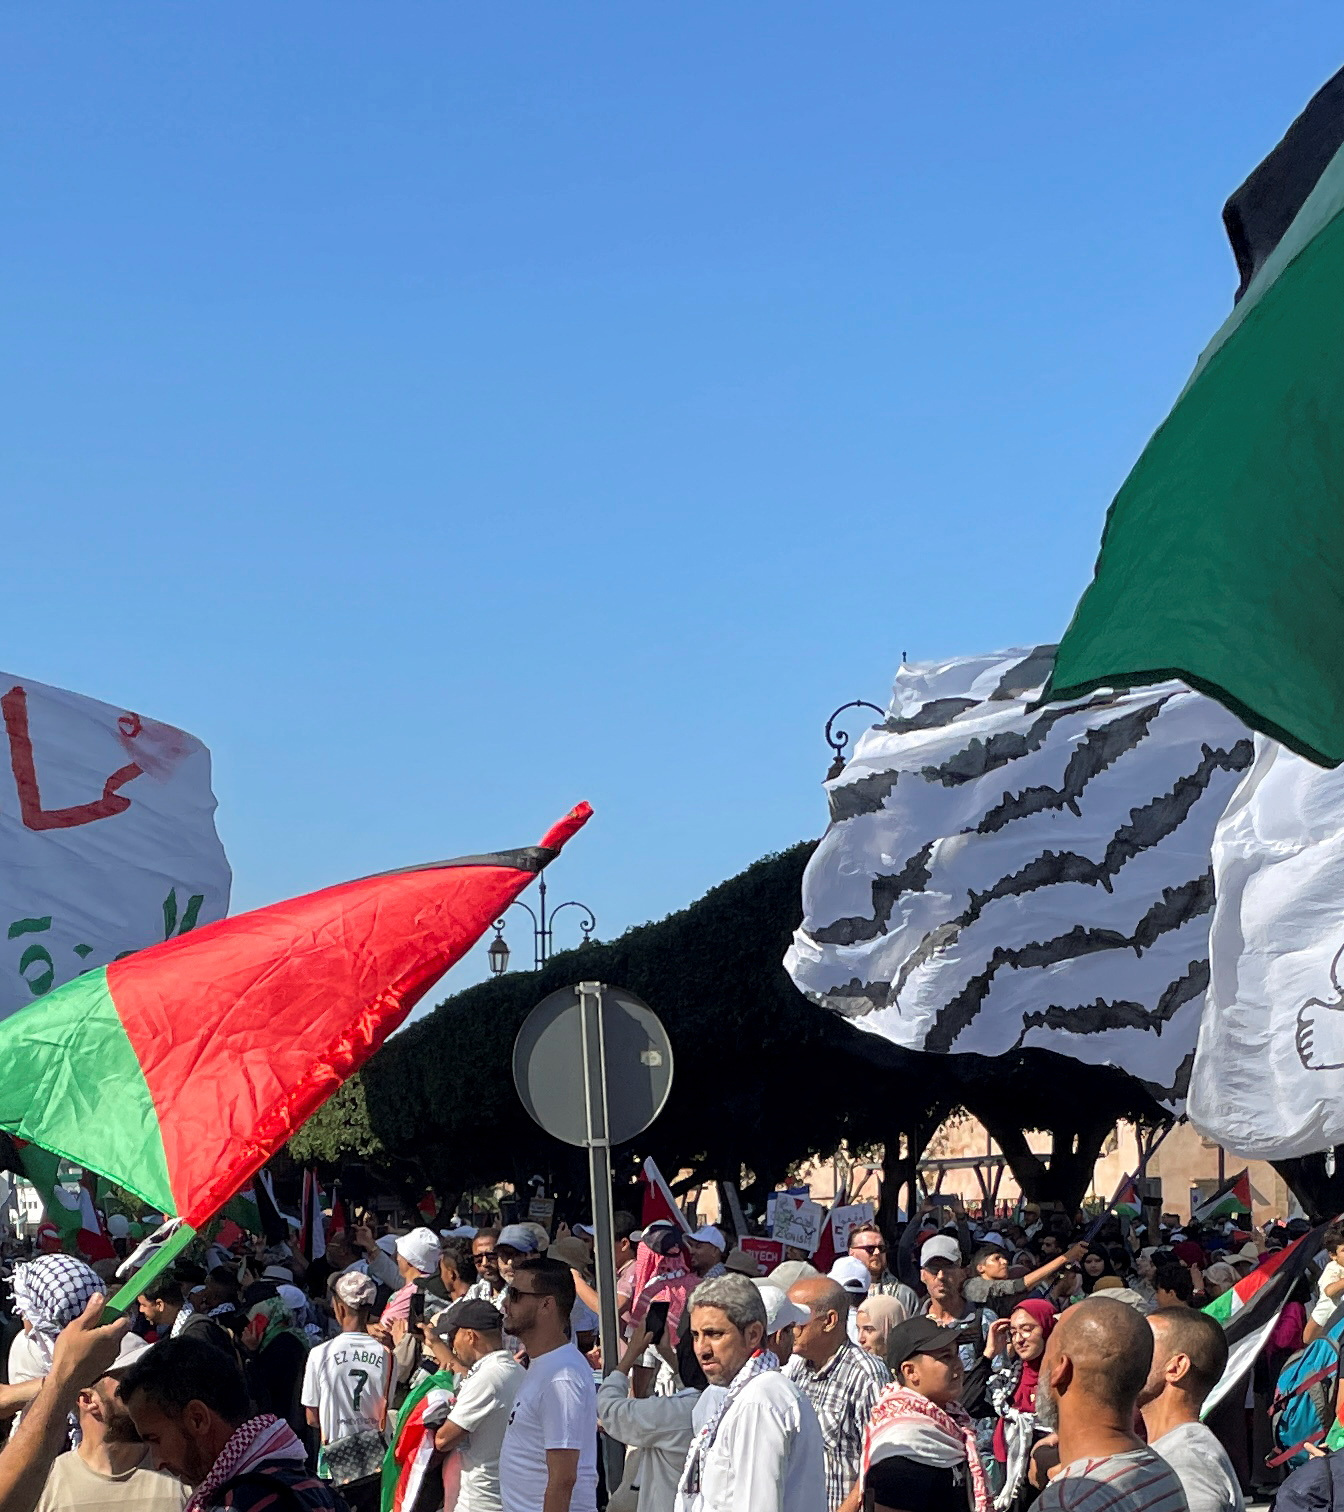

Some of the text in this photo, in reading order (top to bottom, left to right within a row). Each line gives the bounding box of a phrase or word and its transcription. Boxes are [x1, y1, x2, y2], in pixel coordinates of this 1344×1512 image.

[333, 1350, 384, 1368] EZ ABDE
[348, 1368, 369, 1411] 7
